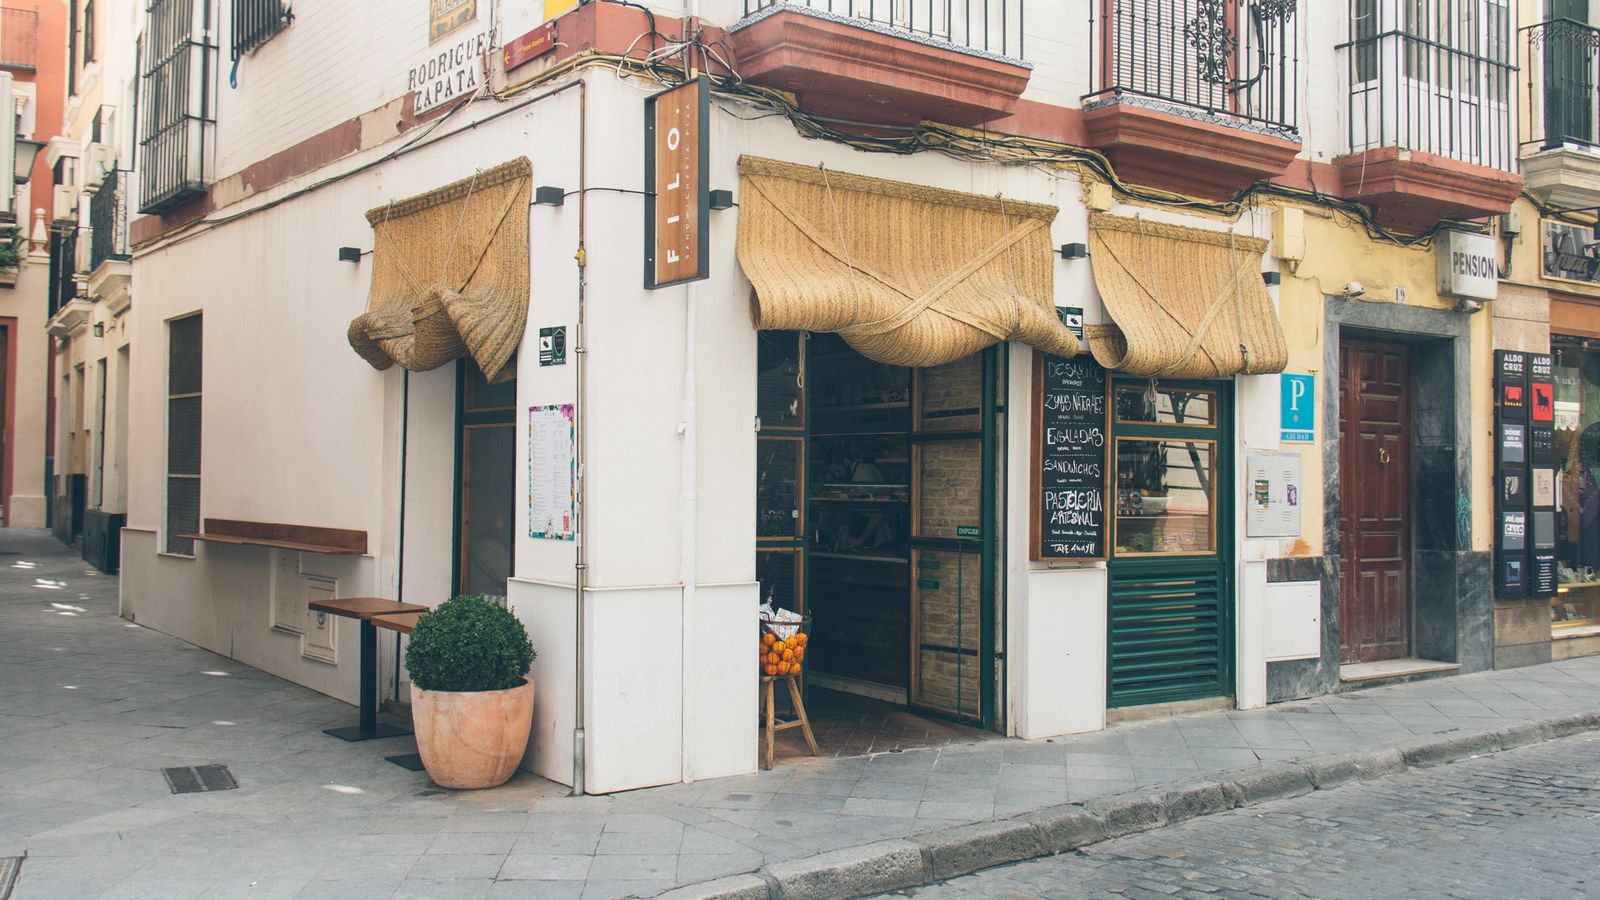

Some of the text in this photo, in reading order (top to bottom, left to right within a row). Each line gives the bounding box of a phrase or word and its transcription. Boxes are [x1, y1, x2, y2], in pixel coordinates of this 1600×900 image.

[407, 28, 497, 91] RODRIGUEZ
[414, 65, 476, 112] ZAPATA
[1453, 251, 1494, 280] PENSION
[1395, 288, 1405, 301] 19
[1503, 354, 1523, 363] ALDO
[1532, 357, 1551, 365] ALDO
[1503, 362, 1523, 372] CRUZ
[1532, 365, 1551, 374] CRUZ
[1290, 379, 1305, 411] P
[1046, 427, 1104, 447] ENSALADAS
[1051, 543, 1070, 554] TAKE
